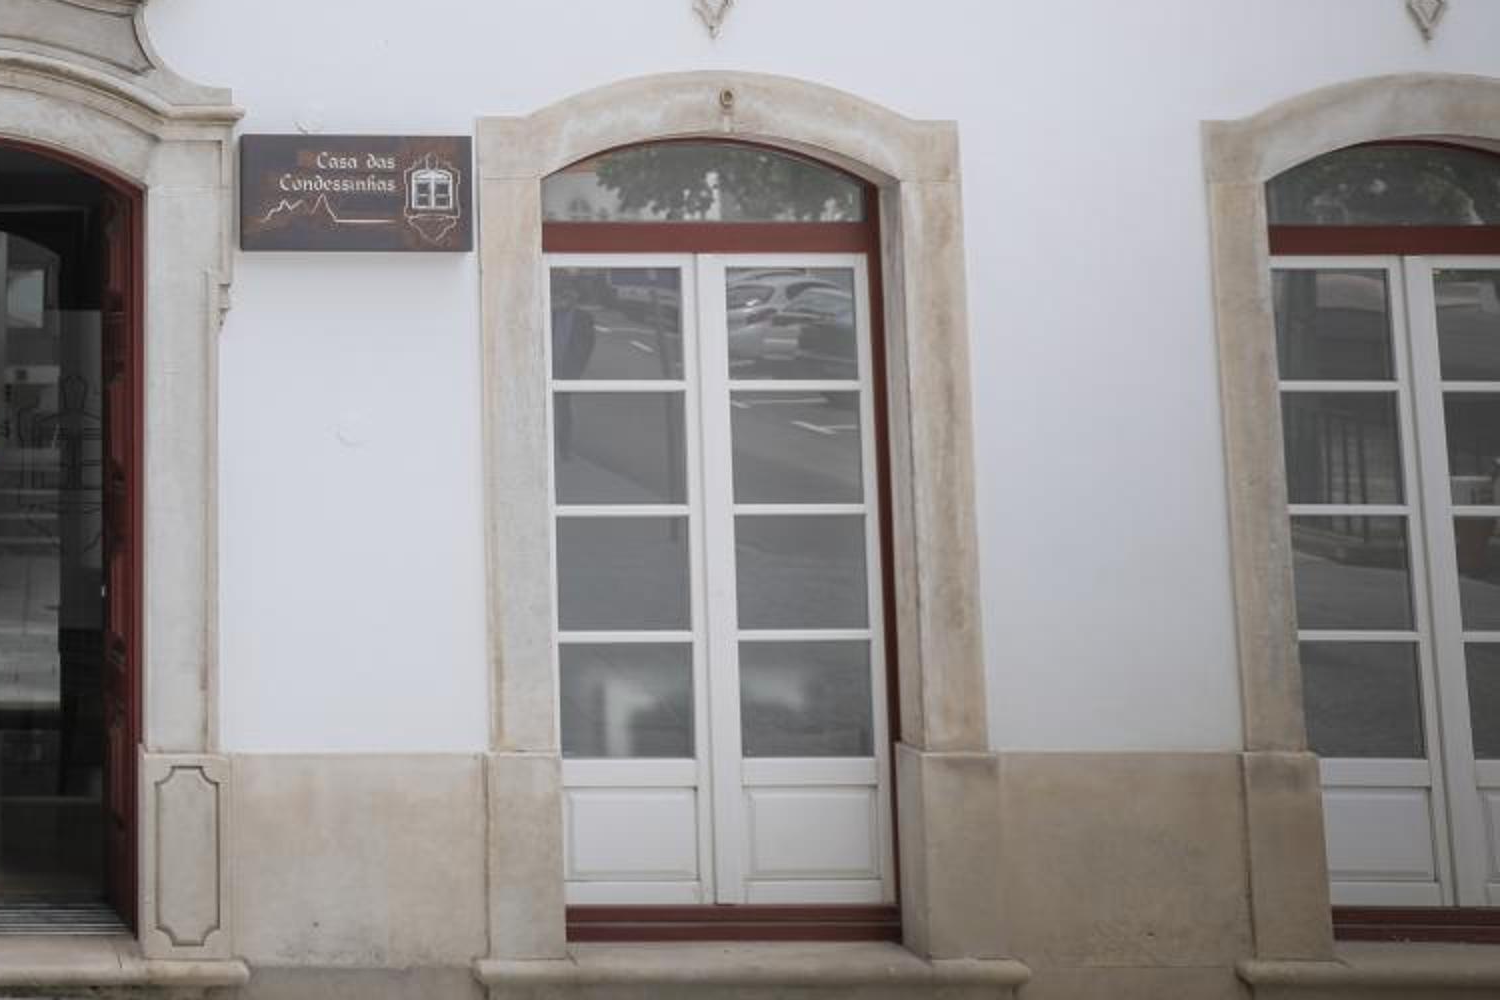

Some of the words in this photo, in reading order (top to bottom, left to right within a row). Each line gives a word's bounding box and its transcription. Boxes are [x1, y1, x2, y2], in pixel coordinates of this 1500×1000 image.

[316, 152, 357, 169] Casa
[366, 153, 395, 169] das
[279, 173, 396, 191] Condessinhas
